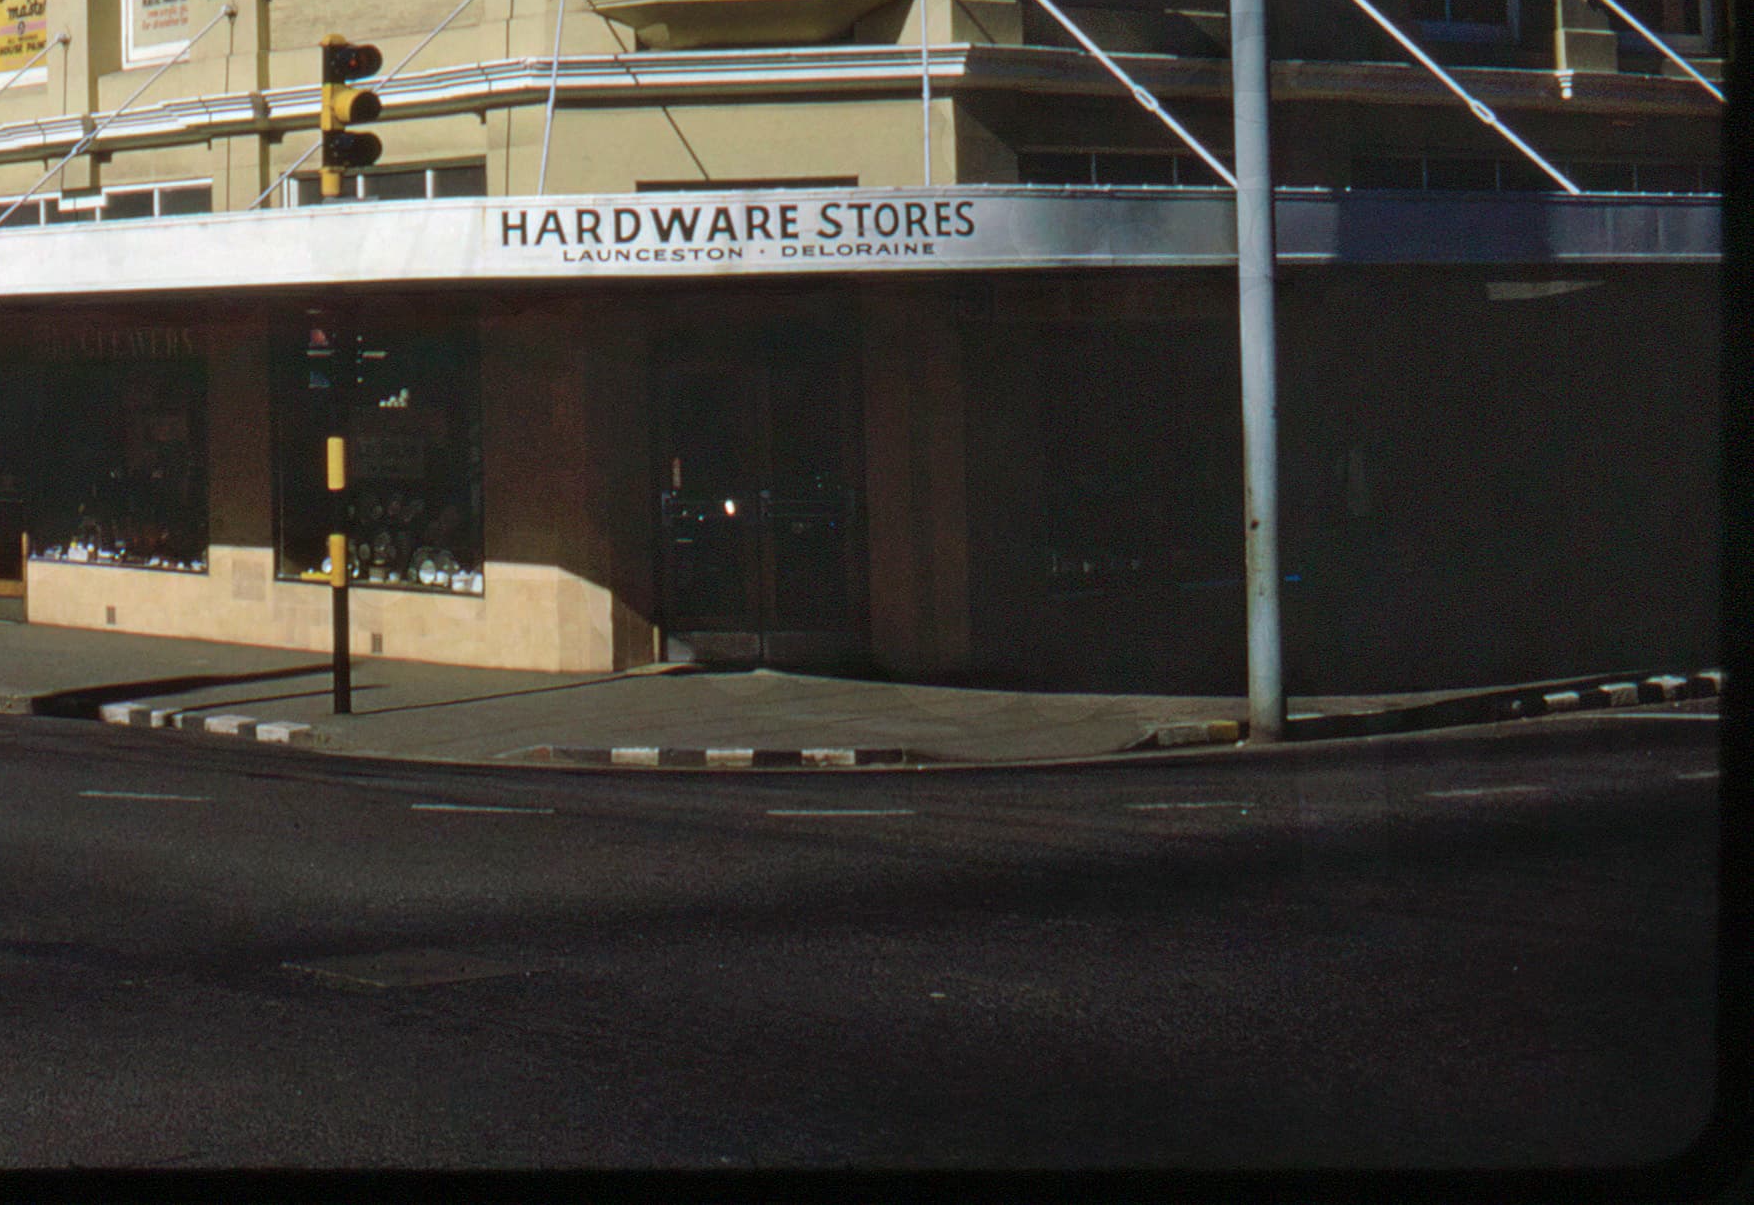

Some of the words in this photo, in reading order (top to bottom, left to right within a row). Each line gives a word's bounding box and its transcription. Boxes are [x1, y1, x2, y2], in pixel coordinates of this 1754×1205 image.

[501, 204, 799, 248] HARDWARE
[817, 201, 976, 239] STORES
[562, 247, 744, 263] LAUNCESTON
[781, 241, 937, 258] DELORAINE
